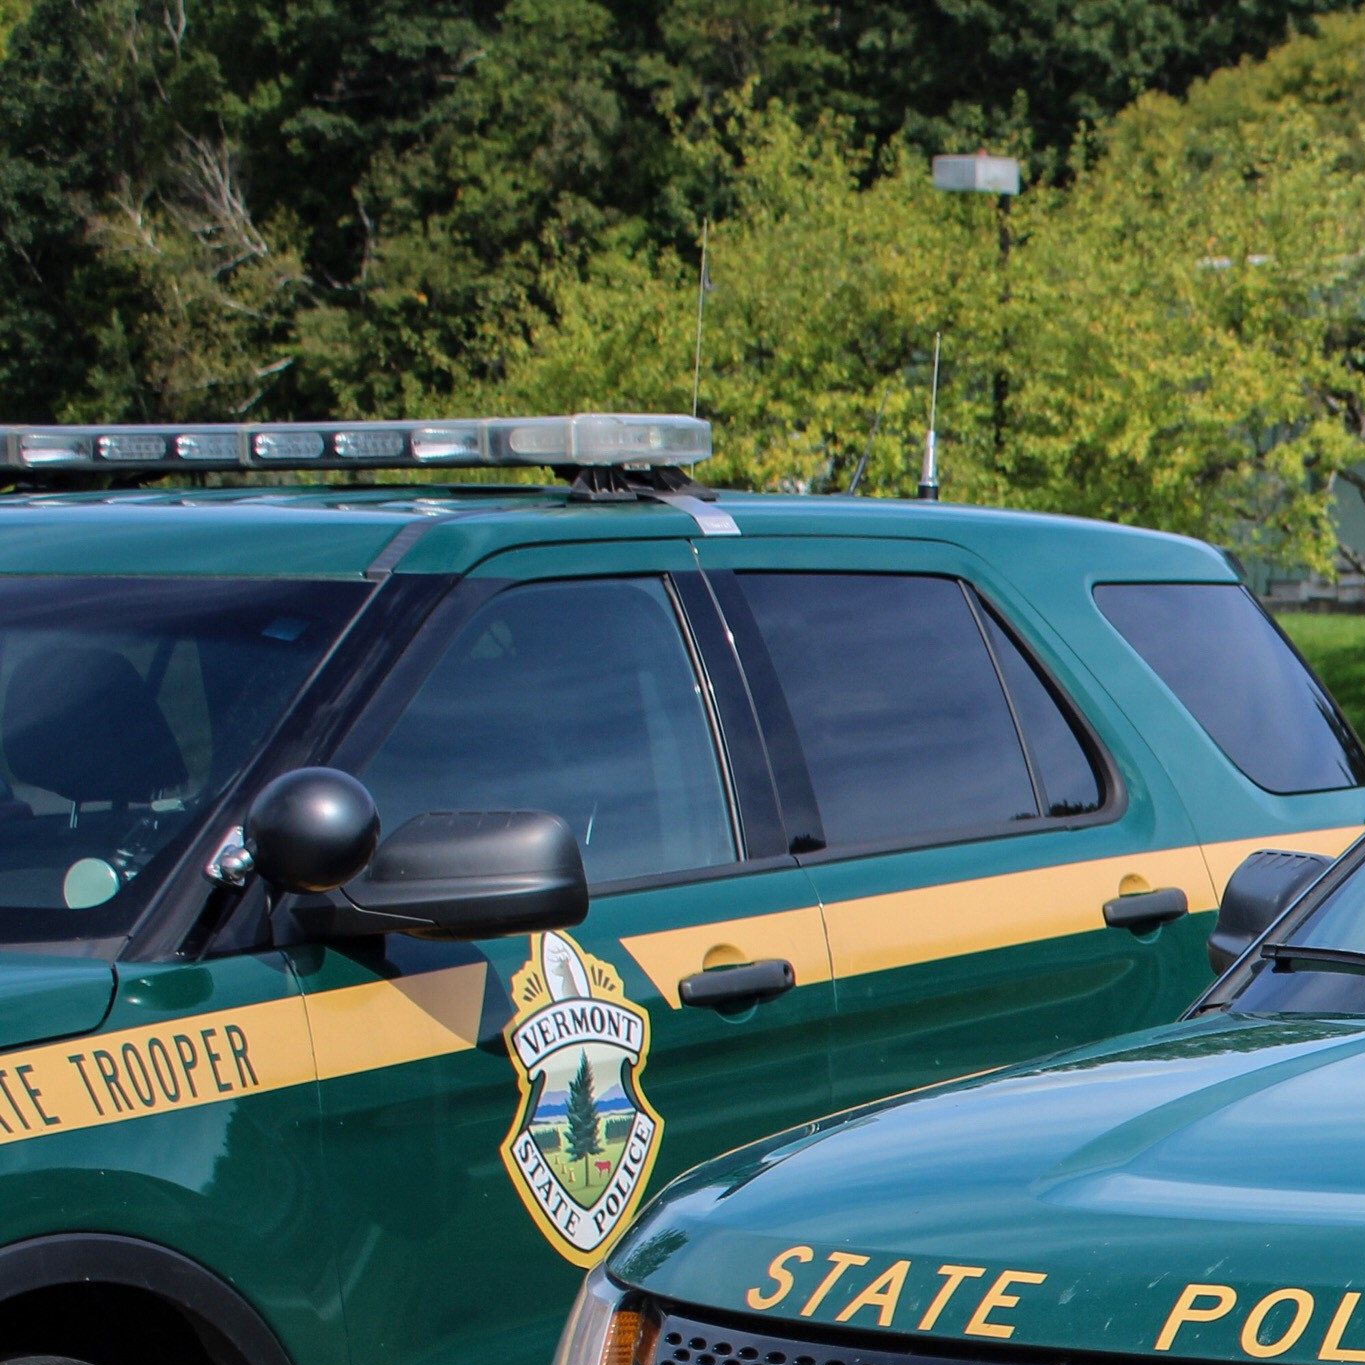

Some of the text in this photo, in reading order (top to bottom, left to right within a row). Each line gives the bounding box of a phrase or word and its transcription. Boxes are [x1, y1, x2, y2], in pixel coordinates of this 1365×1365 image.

[0, 1024, 259, 1133] TE TROOPER
[522, 1006, 639, 1055] VERMONT
[518, 1119, 650, 1238] STATE POLICE
[747, 1245, 1047, 1340] STATE
